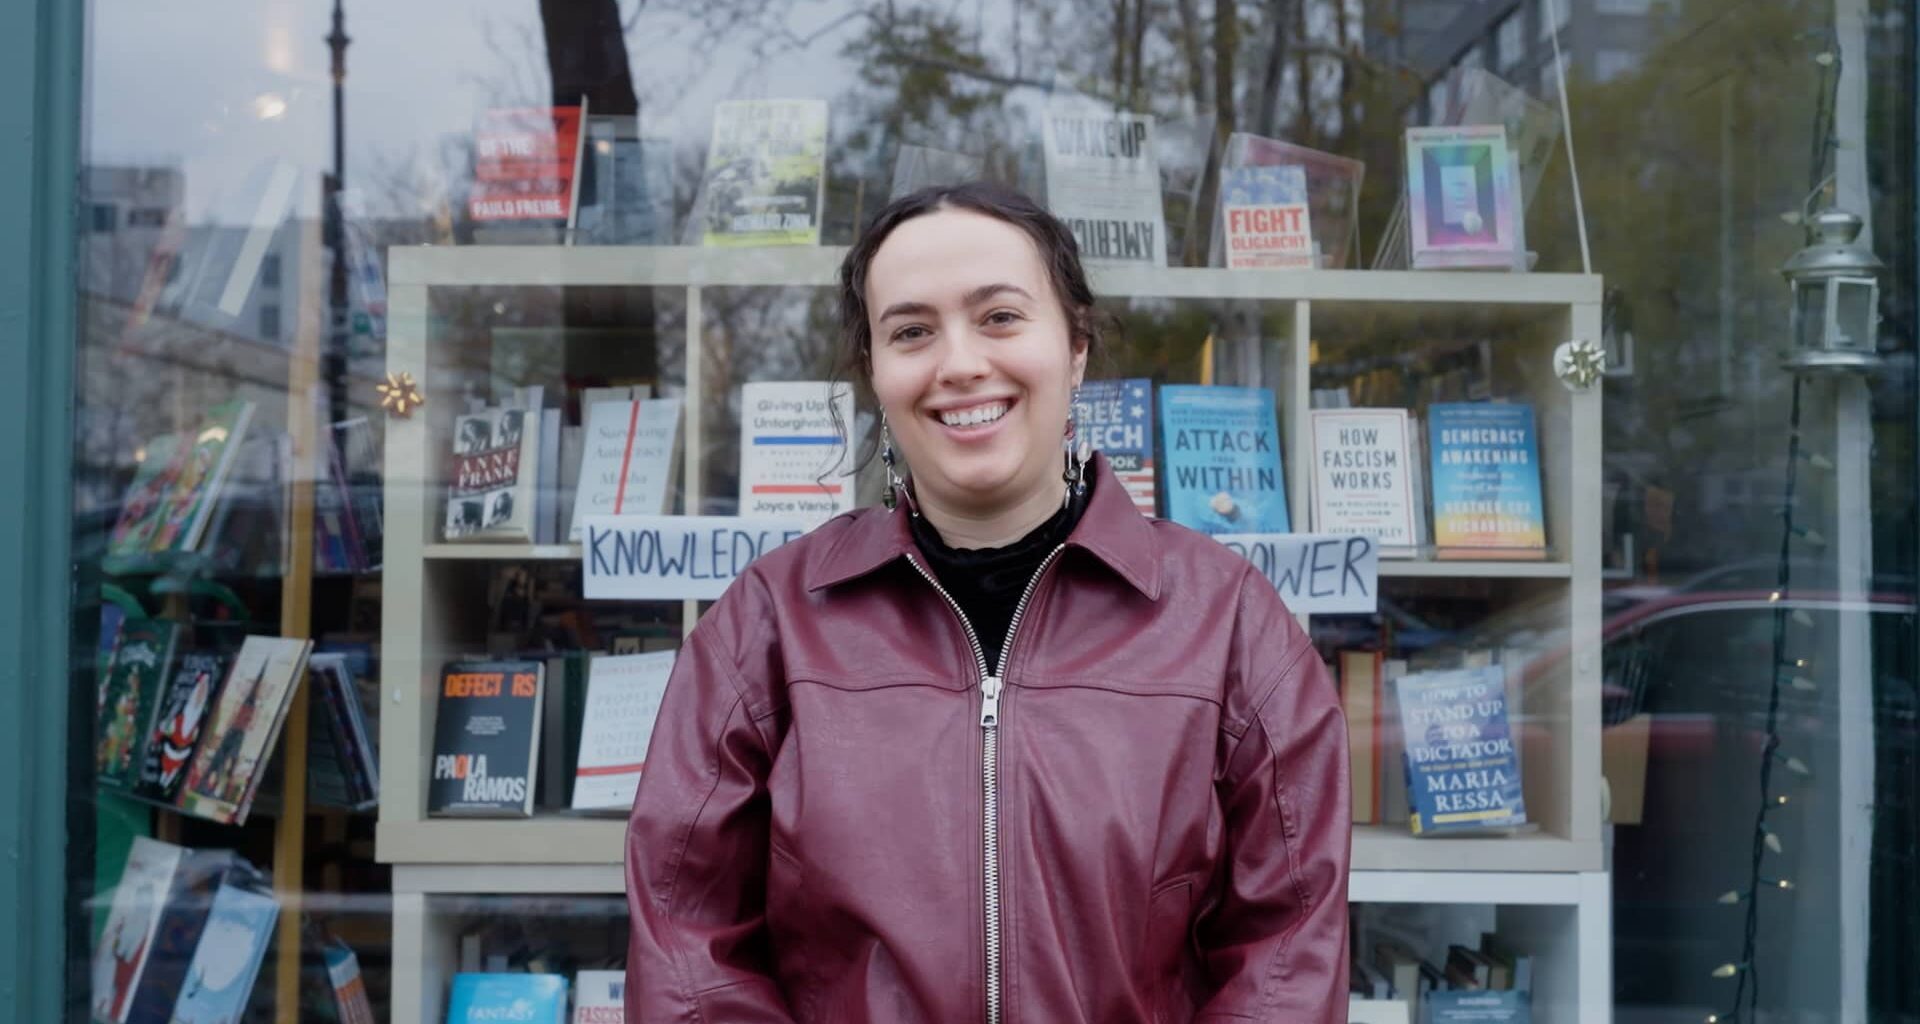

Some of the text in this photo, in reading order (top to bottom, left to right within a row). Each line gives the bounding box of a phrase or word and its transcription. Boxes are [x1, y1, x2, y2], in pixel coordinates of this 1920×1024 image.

[1119, 121, 1147, 158] UP
[473, 199, 562, 217] PAULO FREIRE
[1230, 207, 1304, 235] FIGHT
[1062, 218, 1155, 261] AMERIC
[1231, 234, 1306, 251] OLIGARCHY
[757, 400, 803, 414] Giving
[805, 400, 825, 413] Up
[1073, 400, 1123, 424] REE
[753, 418, 842, 431] Unforgivab
[1075, 424, 1144, 450] EECH
[1175, 428, 1271, 453] ATTACK
[1339, 427, 1378, 446] HOW
[1440, 427, 1526, 445] DEMOCRACY
[462, 447, 520, 475] ANNE
[596, 446, 664, 460] Autoracy
[1322, 449, 1397, 468] FASCISM
[1440, 449, 1529, 465] AWAKENING
[458, 464, 515, 488] FRANK
[600, 472, 648, 485] Maha
[1175, 465, 1277, 491] WITHIN
[1331, 471, 1393, 490] WORKS
[591, 491, 647, 506] Gesen
[753, 501, 841, 515] Joyce Vance
[589, 525, 803, 580] KNOWLED
[445, 673, 537, 697] DEFECT RS
[1422, 683, 1488, 702] HOW TO
[1410, 700, 1503, 723] STAND UP
[1442, 723, 1481, 741] TO A
[1415, 738, 1513, 763] DICTATOR
[435, 754, 487, 780] PAOLA
[463, 776, 526, 803] RAMOS
[1426, 769, 1509, 793] MARIA
[1434, 790, 1504, 813] RESSA
[467, 1006, 536, 1021] FANTASY
[578, 1006, 626, 1024] FASCIS
